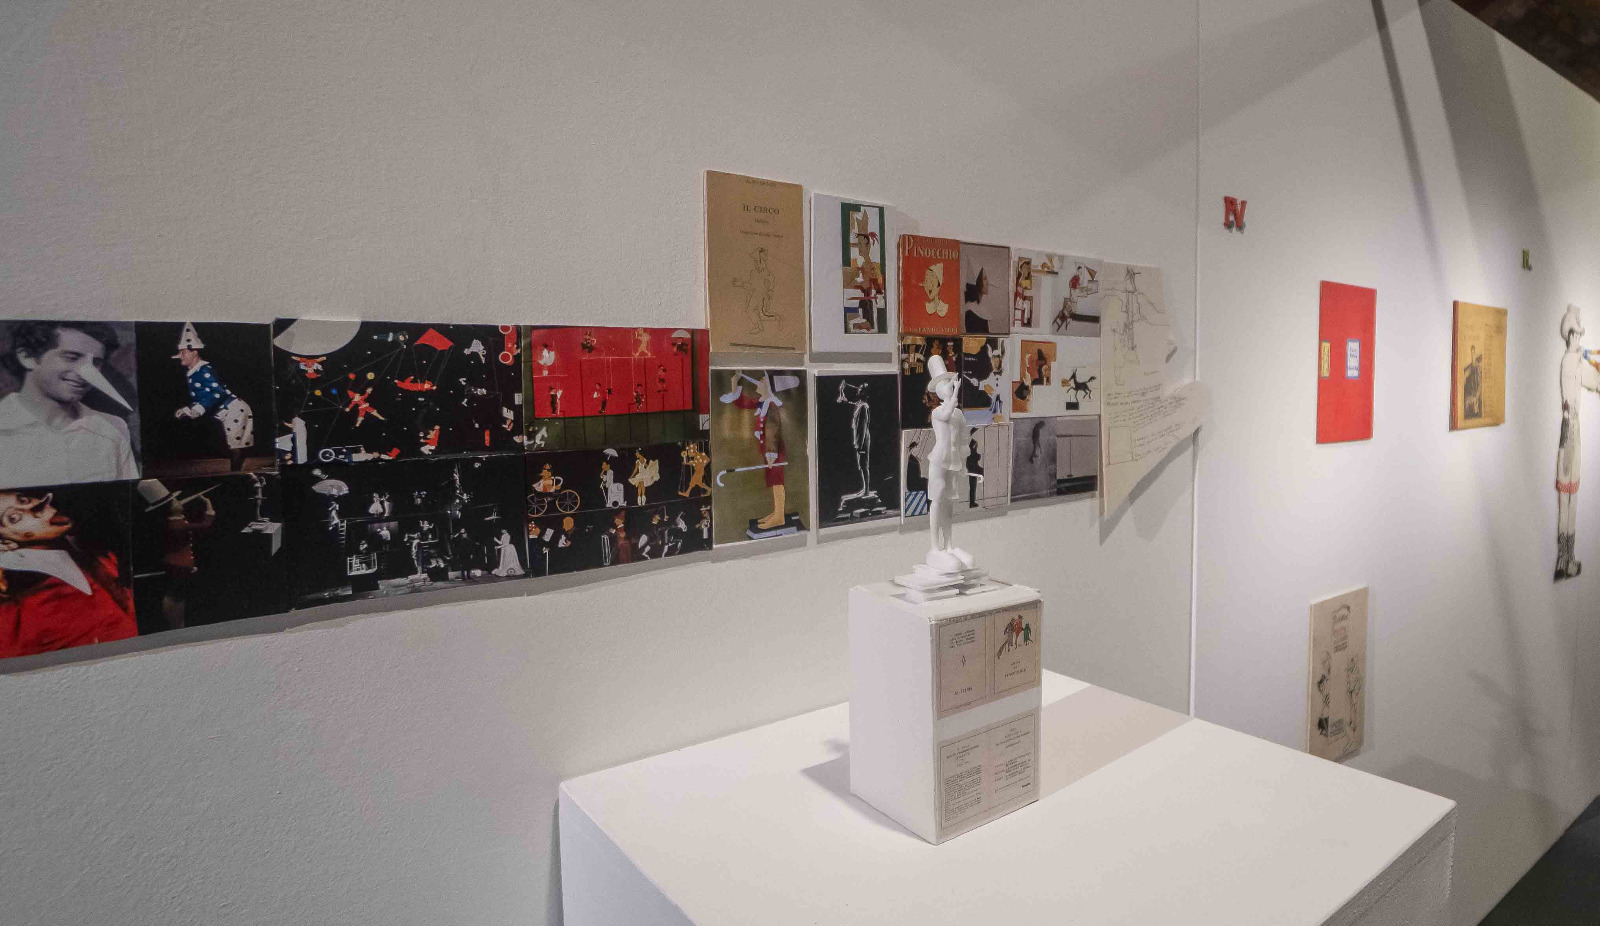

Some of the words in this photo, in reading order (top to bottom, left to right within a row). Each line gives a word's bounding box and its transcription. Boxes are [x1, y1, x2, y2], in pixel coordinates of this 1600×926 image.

[743, 204, 751, 212] IL
[754, 206, 780, 215] CIRCO
[904, 234, 959, 260] PINOCCHIO
